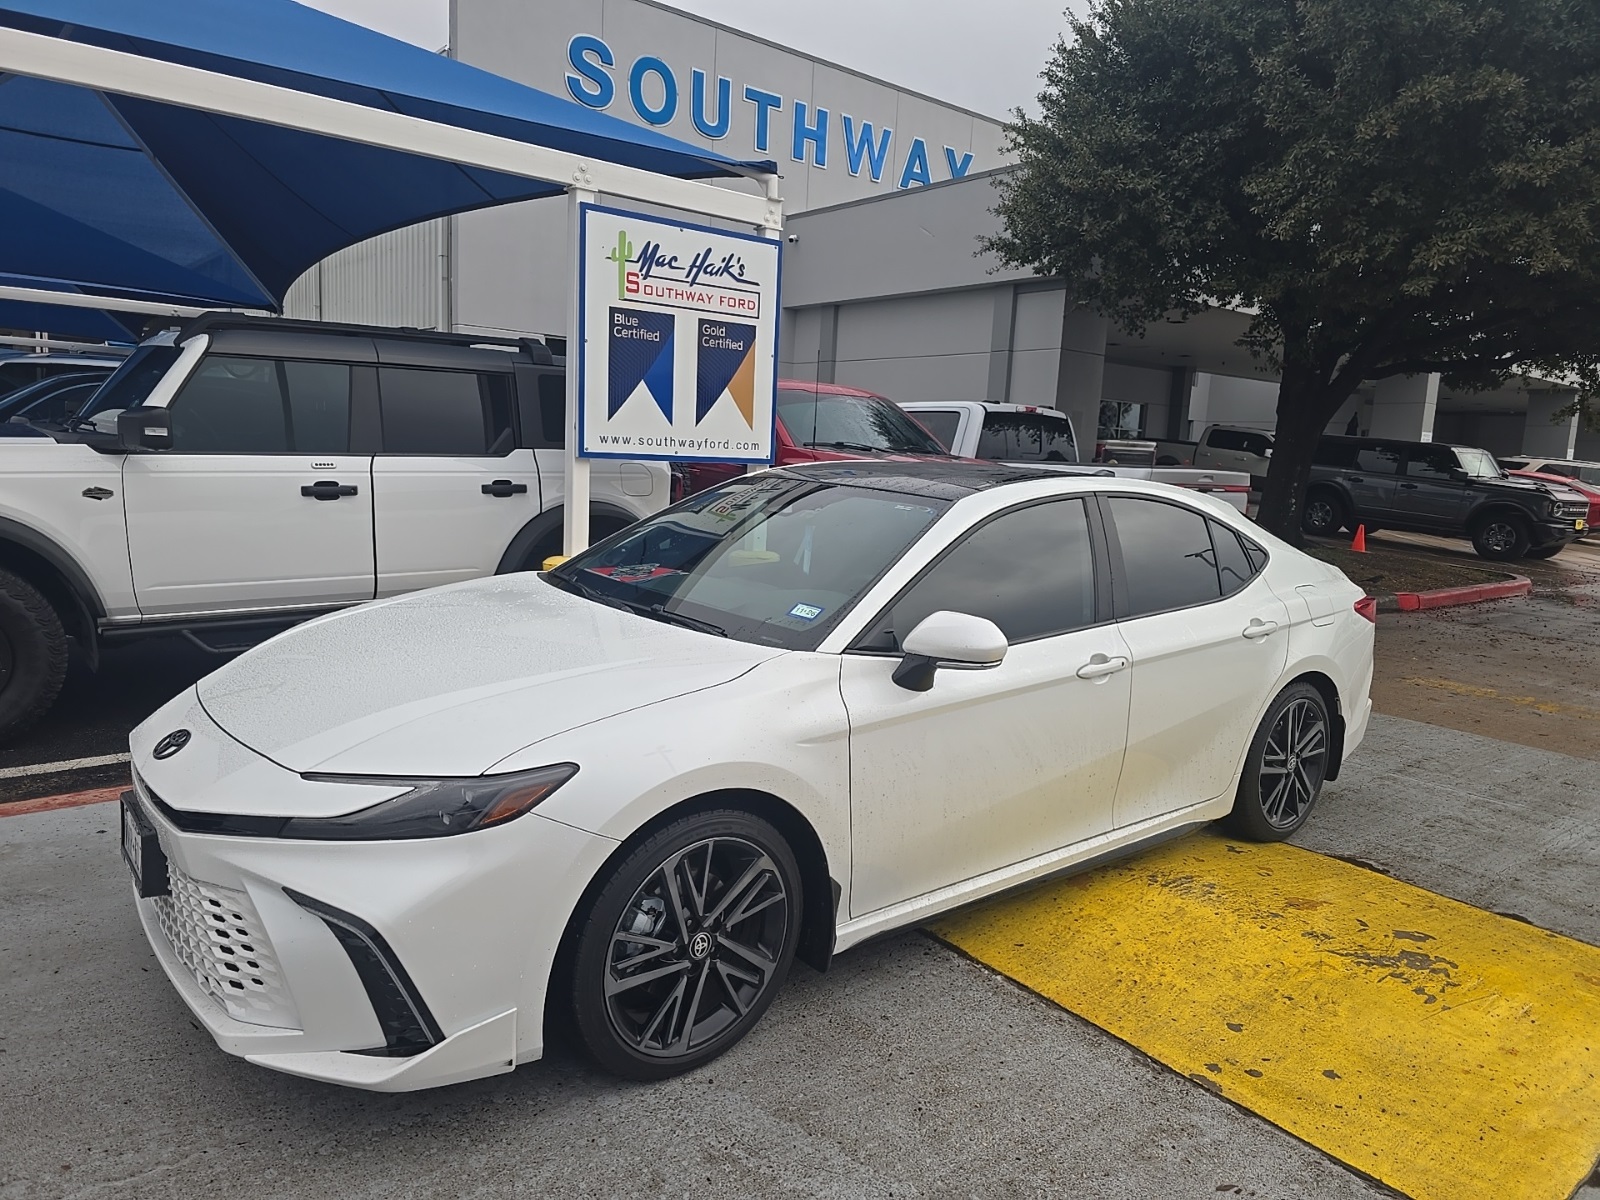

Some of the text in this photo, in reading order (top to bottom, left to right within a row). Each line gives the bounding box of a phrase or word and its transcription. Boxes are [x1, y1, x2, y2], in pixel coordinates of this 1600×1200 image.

[565, 34, 975, 189] SOUTHWAY
[638, 240, 760, 287] Mac Haik's
[626, 271, 756, 311] SOUTHWAY FORD
[614, 313, 639, 327] Blue
[613, 326, 660, 342] Certified
[702, 324, 726, 337] Gold
[702, 336, 743, 351] Certified
[599, 435, 760, 451] www.southwayford.com
